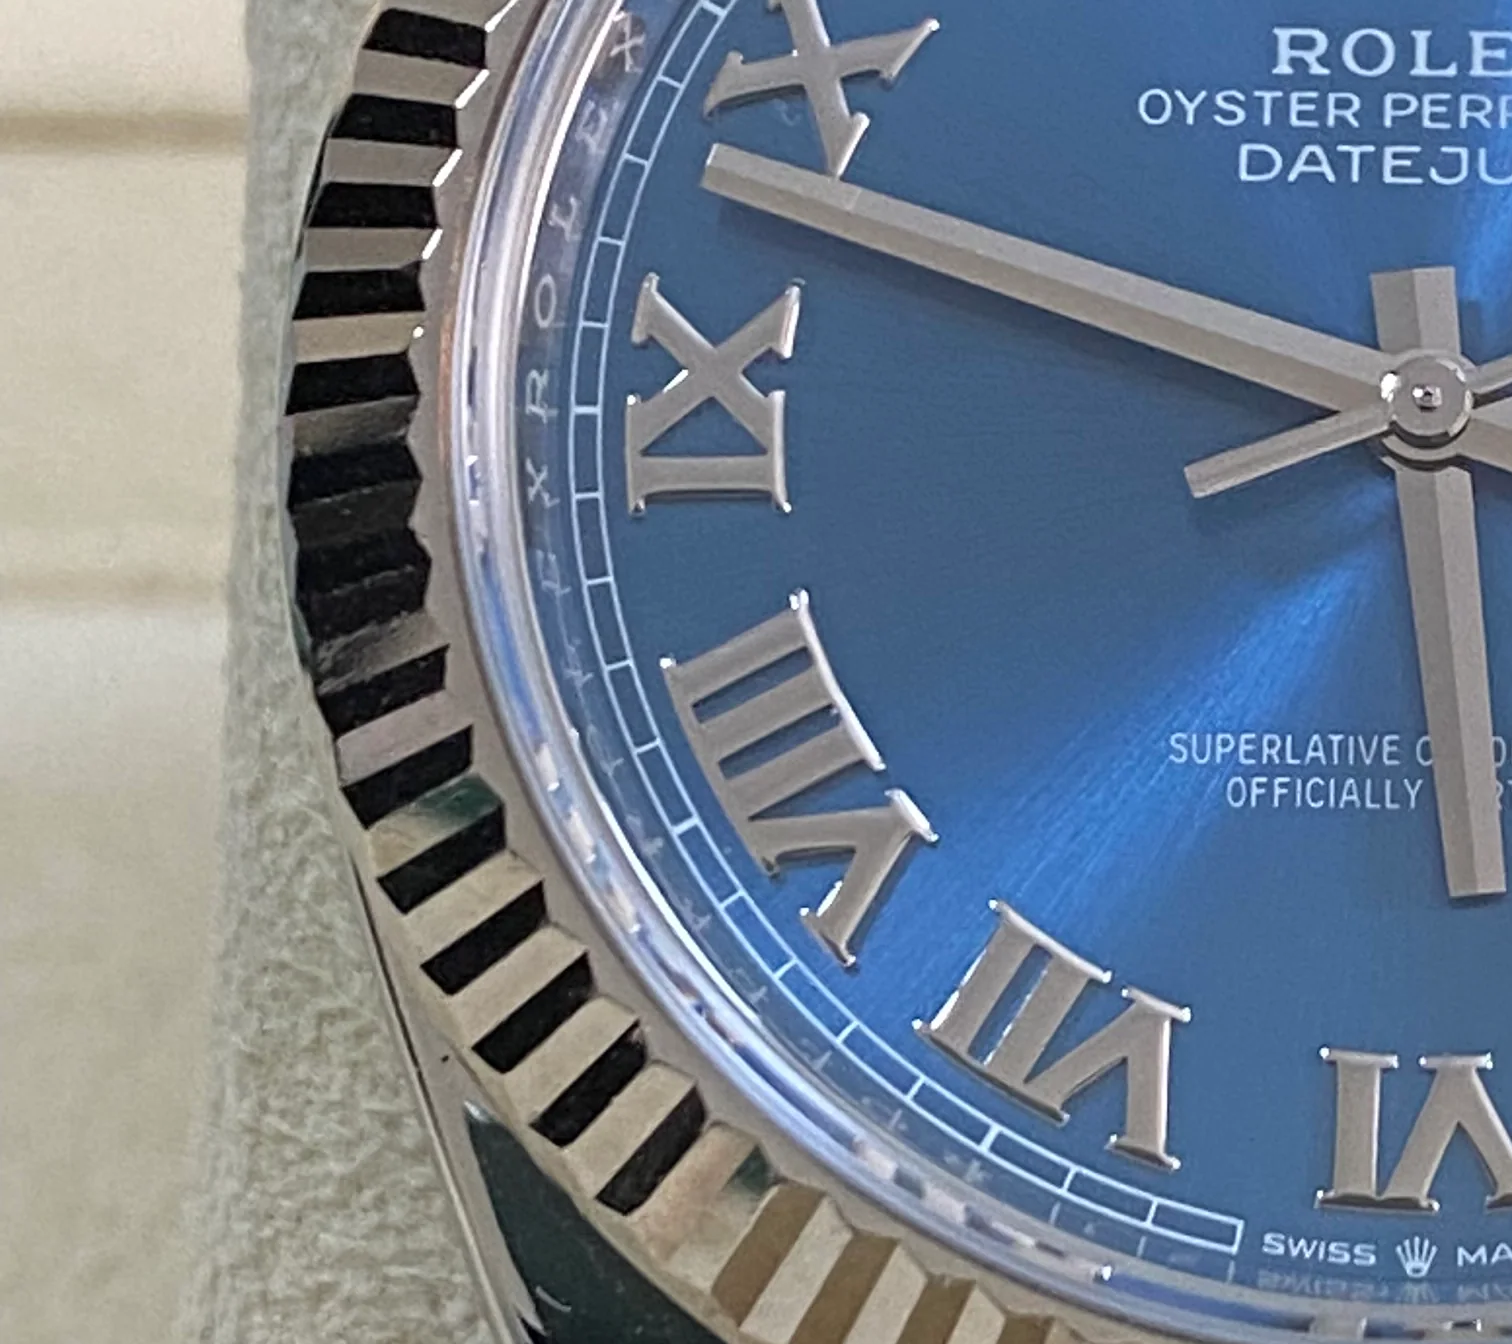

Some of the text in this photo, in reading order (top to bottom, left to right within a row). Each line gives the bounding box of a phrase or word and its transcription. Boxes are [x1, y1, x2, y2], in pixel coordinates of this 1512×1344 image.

[1138, 89, 1360, 128] OYSTER
[625, 273, 805, 517] IX
[1168, 732, 1401, 767] SUPERLATIVE
[660, 590, 939, 968] VIII
[1226, 776, 1424, 811] OFFICIALLY
[912, 898, 1191, 1172] VII
[1262, 1231, 1377, 1266] SWISS
